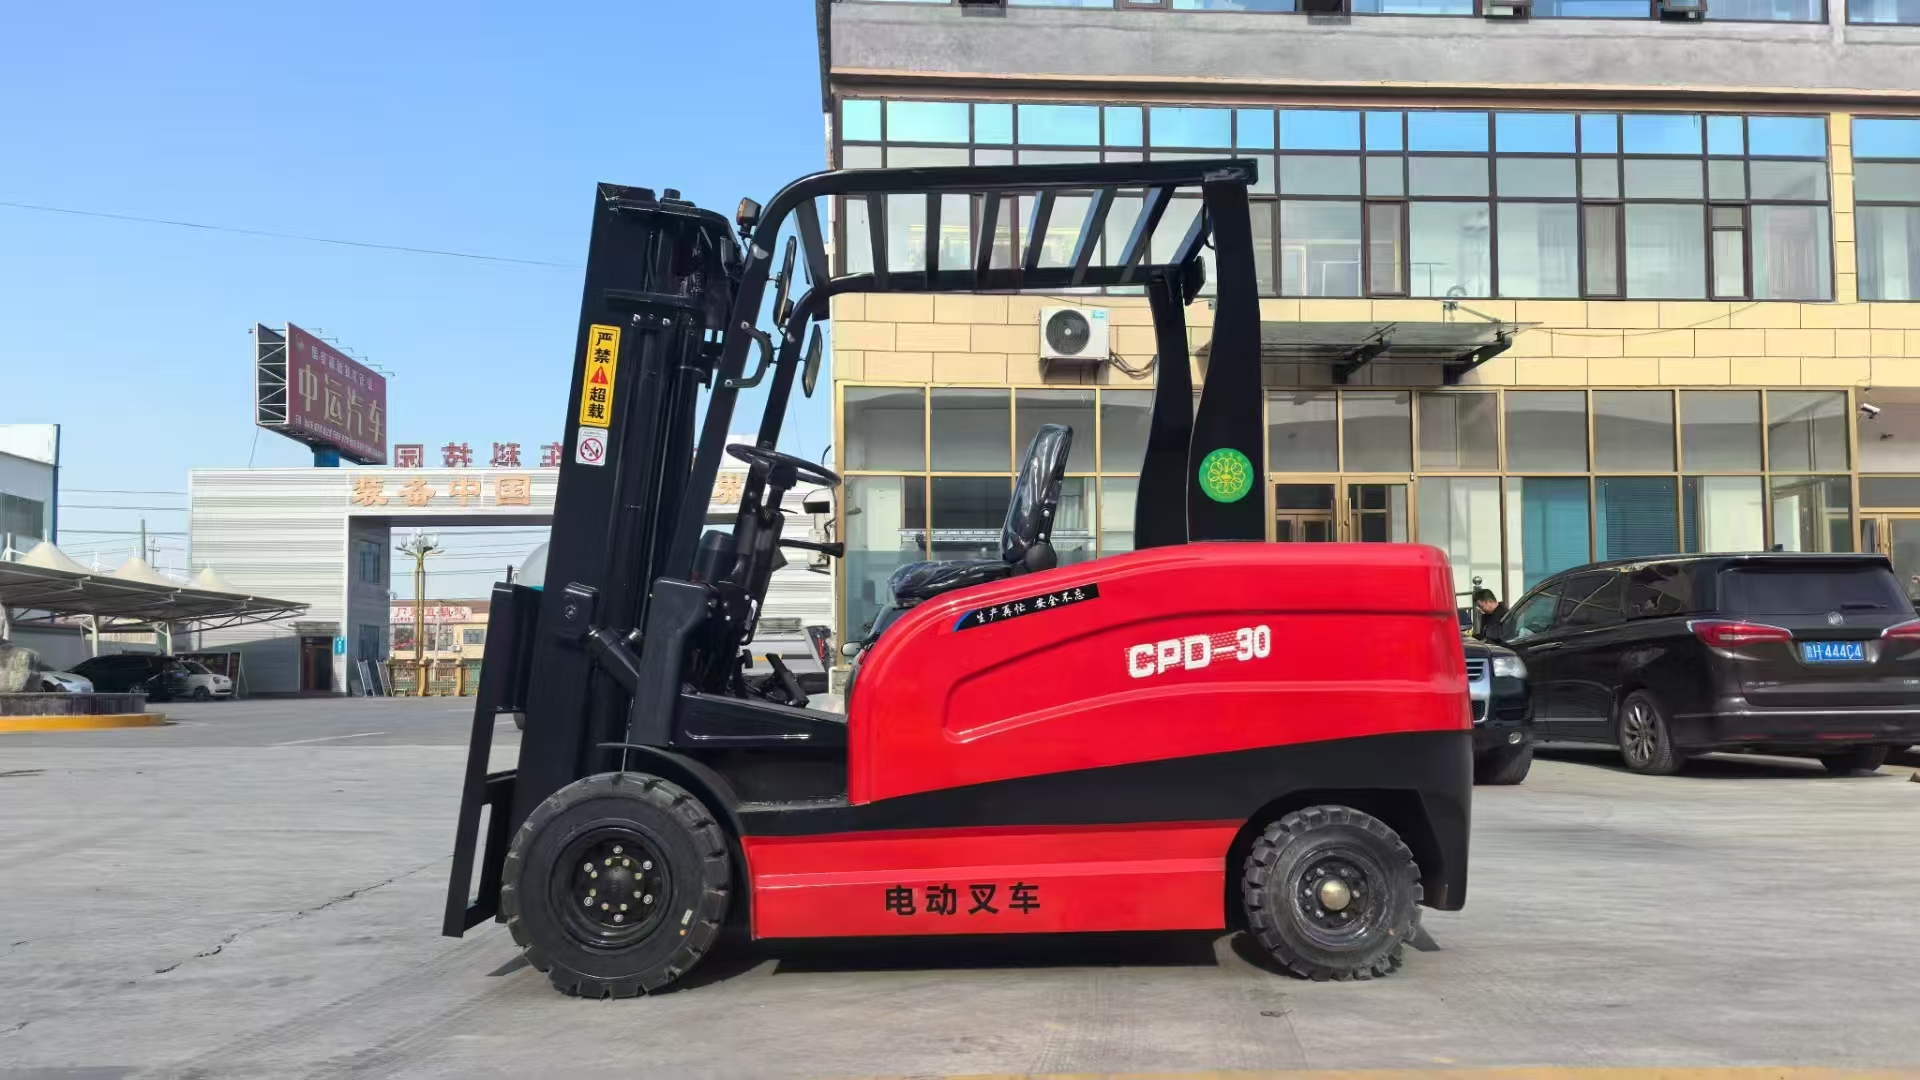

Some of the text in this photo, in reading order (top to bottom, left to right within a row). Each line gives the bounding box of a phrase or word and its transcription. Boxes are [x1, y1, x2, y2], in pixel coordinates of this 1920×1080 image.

[298, 364, 385, 443] 中运汽车
[352, 474, 531, 507] 装备中国
[976, 588, 1085, 624] 生产再忙 安全不忘
[1128, 624, 1271, 678] CPD-30
[886, 882, 1041, 916] 电动叉车
